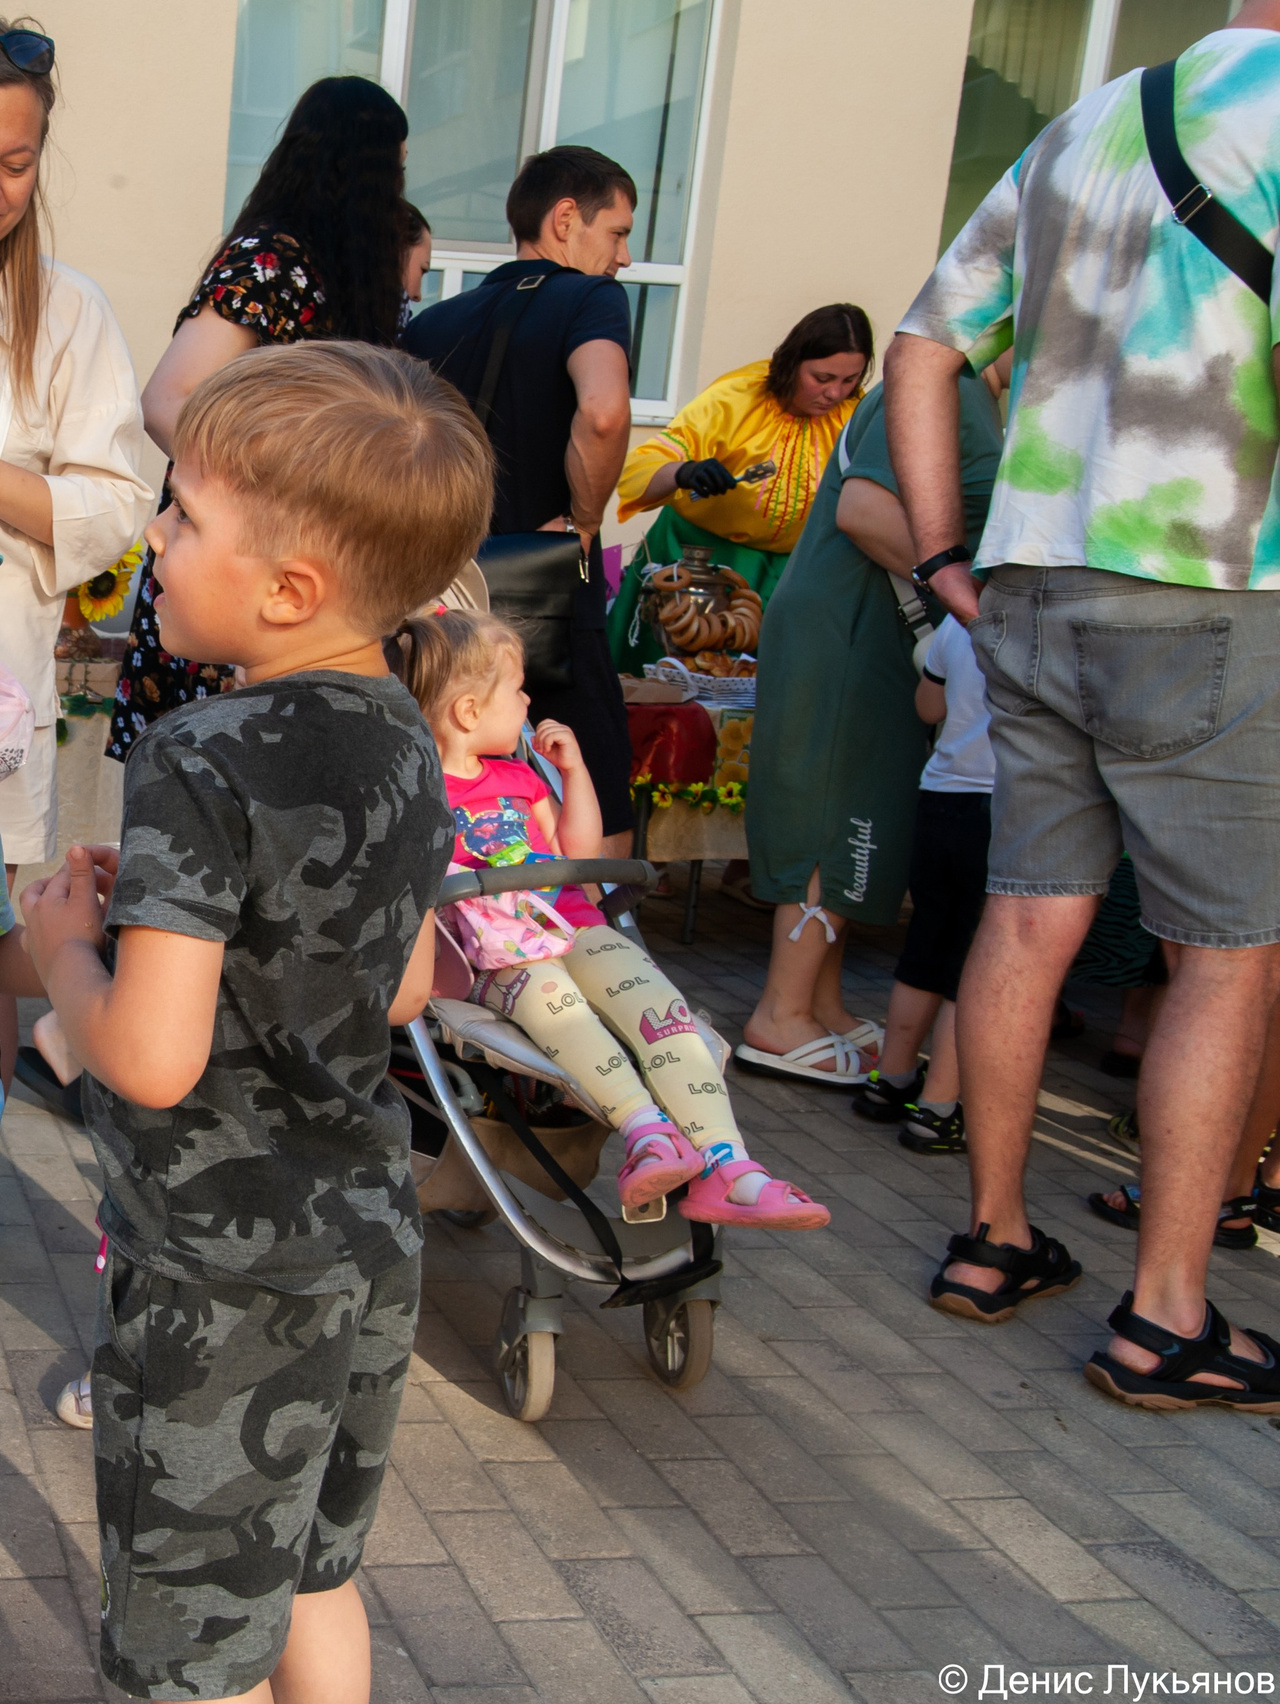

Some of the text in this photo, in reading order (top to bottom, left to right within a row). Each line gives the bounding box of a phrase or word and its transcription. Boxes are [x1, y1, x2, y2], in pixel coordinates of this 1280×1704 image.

[843, 816, 878, 903] beautiful
[586, 942, 631, 957] LOL
[605, 976, 650, 998] LOL
[546, 991, 585, 1016] LOL
[687, 1081, 727, 1097] LOL
